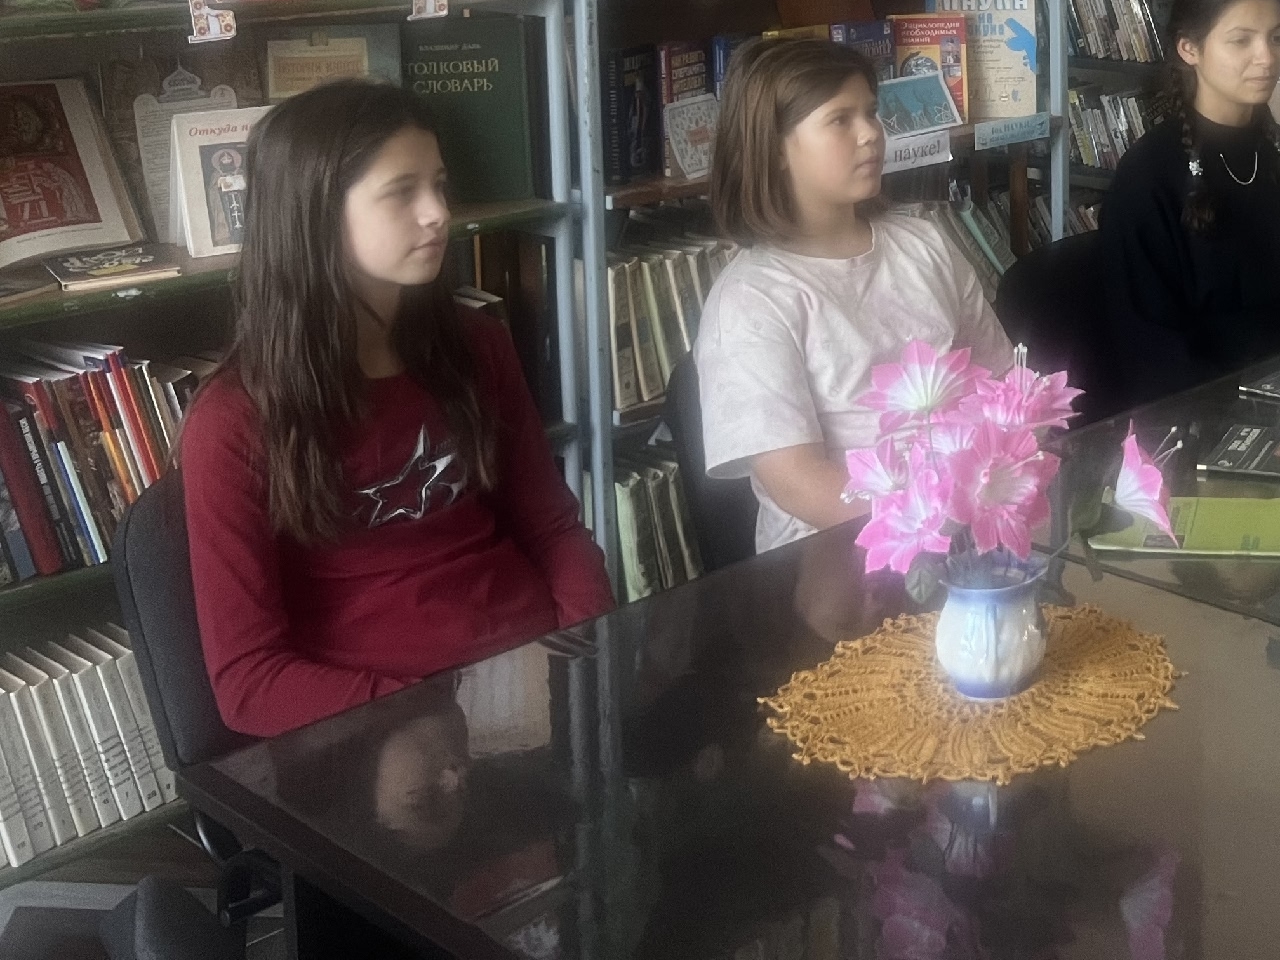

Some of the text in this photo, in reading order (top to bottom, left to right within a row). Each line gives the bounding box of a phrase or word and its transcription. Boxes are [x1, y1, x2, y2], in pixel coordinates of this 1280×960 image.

[902, 21, 960, 30] Энциклопедия
[407, 57, 500, 75] ТОЛКОВЫЙ
[412, 77, 494, 94] СЛОВАРЬ
[188, 124, 238, 138] Откуда
[894, 138, 942, 163] науке!
